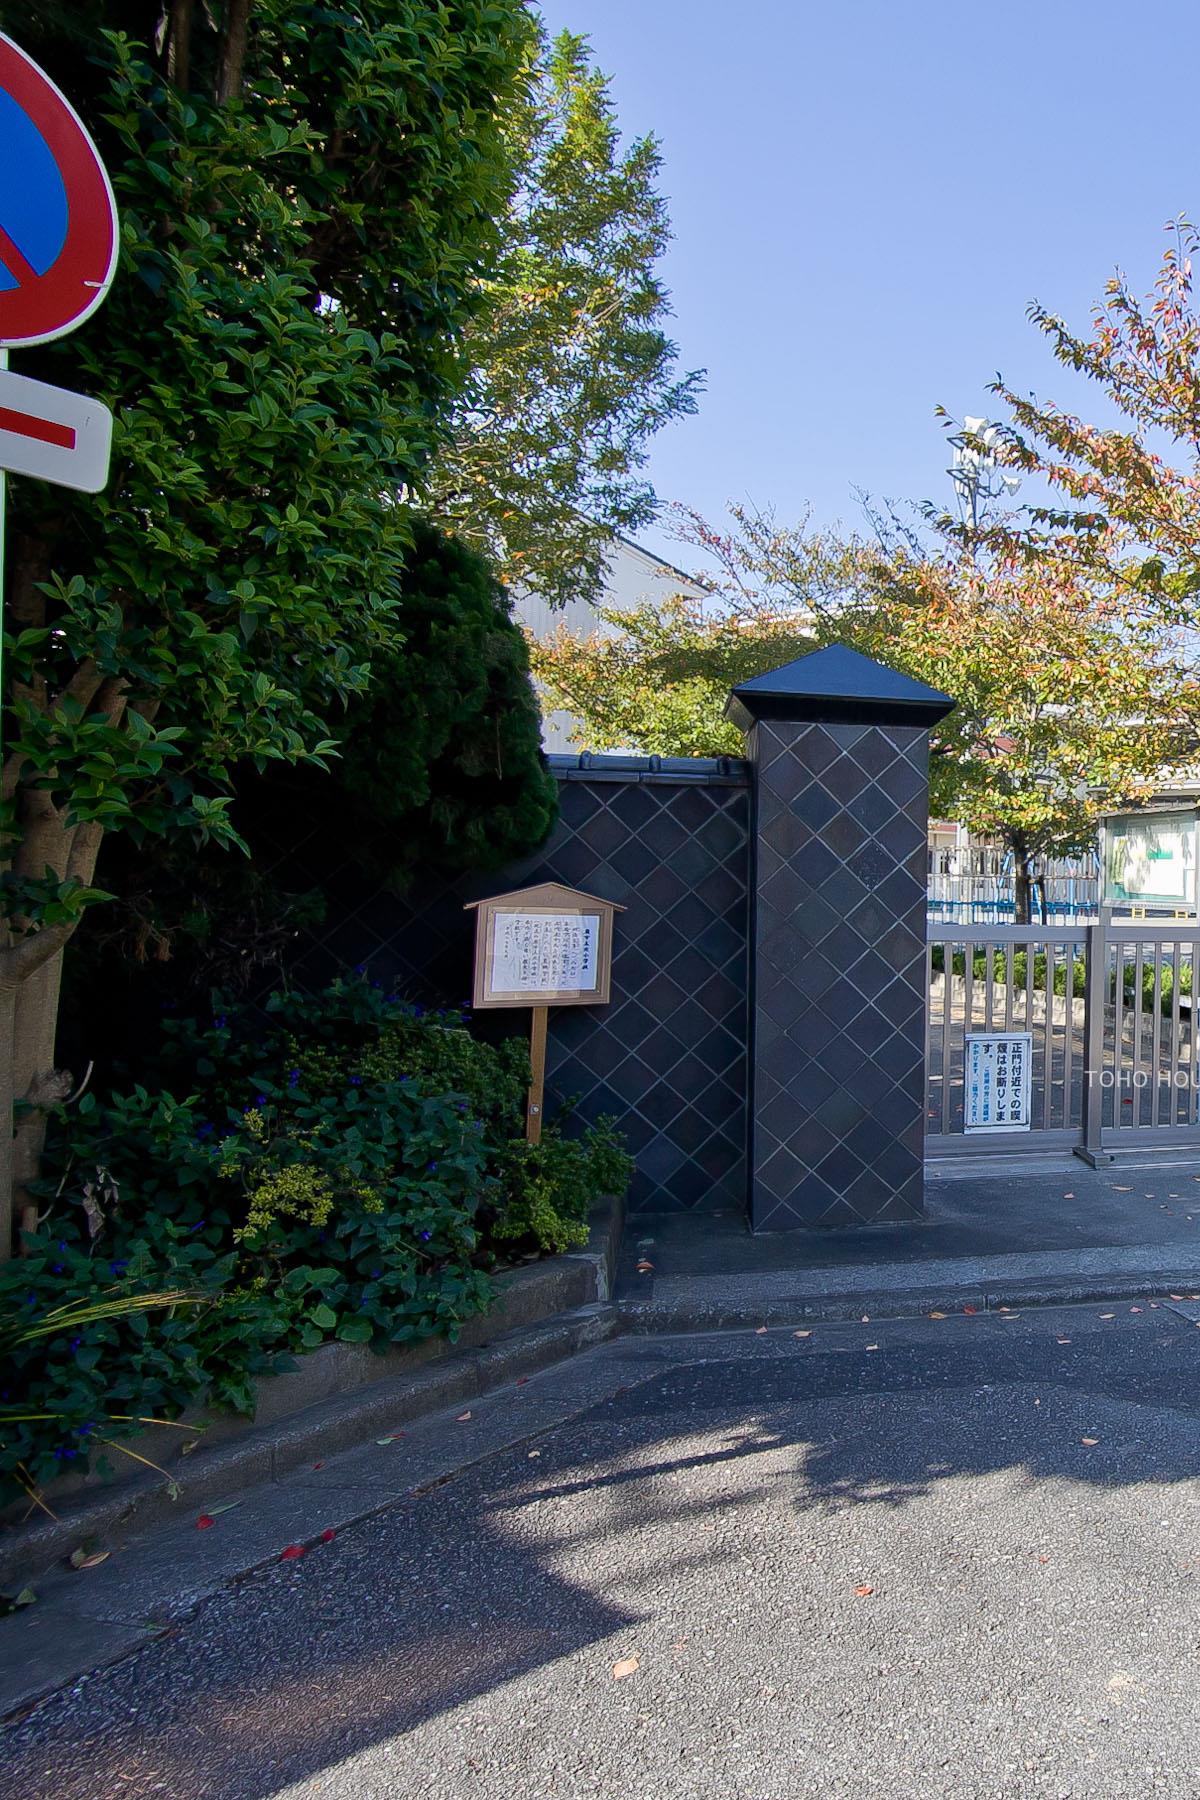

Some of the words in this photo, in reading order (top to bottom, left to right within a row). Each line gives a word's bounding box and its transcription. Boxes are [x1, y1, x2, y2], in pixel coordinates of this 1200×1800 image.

[1010, 1042, 1022, 1120] 正門付近での喫
